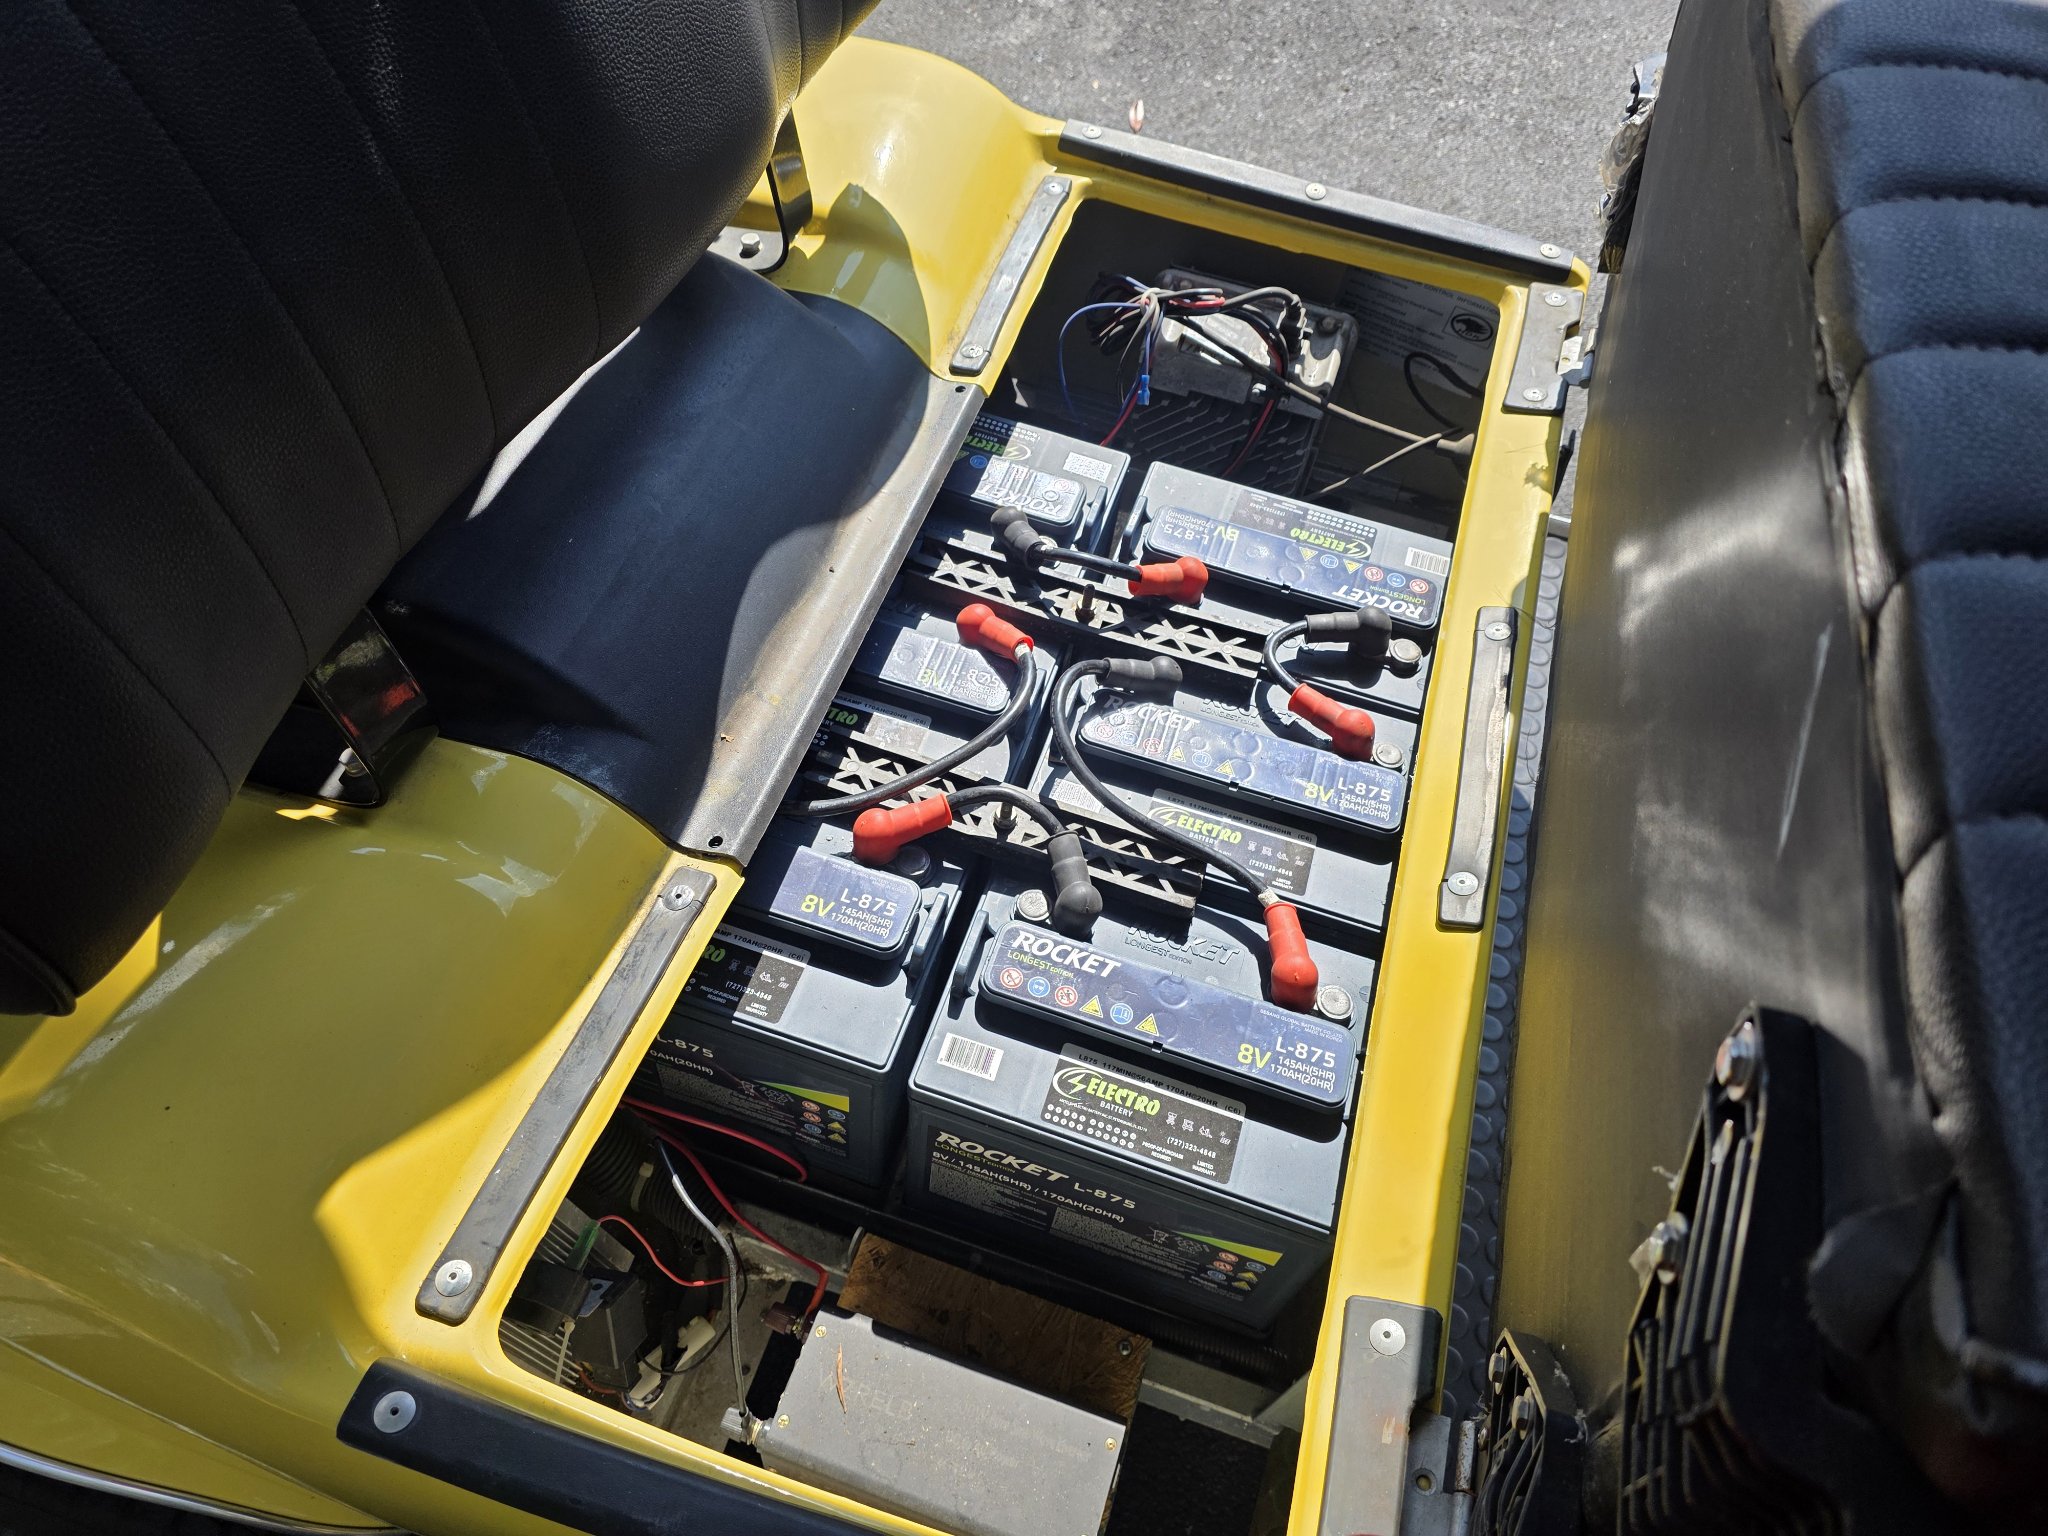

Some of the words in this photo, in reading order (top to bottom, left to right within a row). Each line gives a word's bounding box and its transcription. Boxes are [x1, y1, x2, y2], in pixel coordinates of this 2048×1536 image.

[964, 436, 1005, 455] ELECT
[981, 483, 1062, 515] ROCKET
[1163, 523, 1209, 544] L-875
[1290, 527, 1346, 552] ELECTRO
[1309, 527, 1336, 538] BATTERY
[1331, 584, 1424, 619] ROCKET
[1389, 590, 1426, 606] LONGEST
[1103, 694, 1201, 732] ROCKET
[1304, 780, 1335, 803] 8V
[1337, 777, 1392, 802] L-875
[1340, 792, 1392, 813] 145AH(5HR)
[1333, 798, 1390, 821] 170AH(20HR)
[1176, 814, 1242, 845] ELECTRO
[1188, 831, 1219, 845] BATTERY
[800, 894, 836, 918] 8V
[840, 887, 898, 917] L-875
[831, 912, 890, 939] 170AH(20HR)
[840, 905, 894, 931] 145AH(5HR)
[734, 934, 784, 955] 170AH@20HR
[788, 952, 804, 962] (C6)
[1011, 930, 1122, 978] ROCKET
[1125, 936, 1171, 957] LONGEST
[1007, 949, 1052, 971] LONGEST
[656, 1034, 714, 1058] L-875
[1237, 1043, 1272, 1069] 8V
[1275, 1036, 1336, 1068] L-875
[649, 1049, 714, 1075] 0AH(20HR)
[1278, 1056, 1336, 1083] 145AH(5HR)
[1078, 1054, 1098, 1065] L875
[1166, 1084, 1218, 1107] 170AH@20HR
[1224, 1103, 1241, 1115] (C6)
[1270, 1064, 1334, 1093] 170AH(20HR)
[1086, 1076, 1161, 1116] ELECTRO
[1099, 1100, 1134, 1117] BATTERY
[934, 1141, 989, 1164] LONGEST
[935, 1131, 1070, 1182] ROCKET
[1073, 1182, 1136, 1209] L-875
[932, 1151, 949, 1161] 8V
[958, 1160, 1032, 1191] 145AH(5HR)
[1042, 1189, 1125, 1223] 170AH(20HR)
